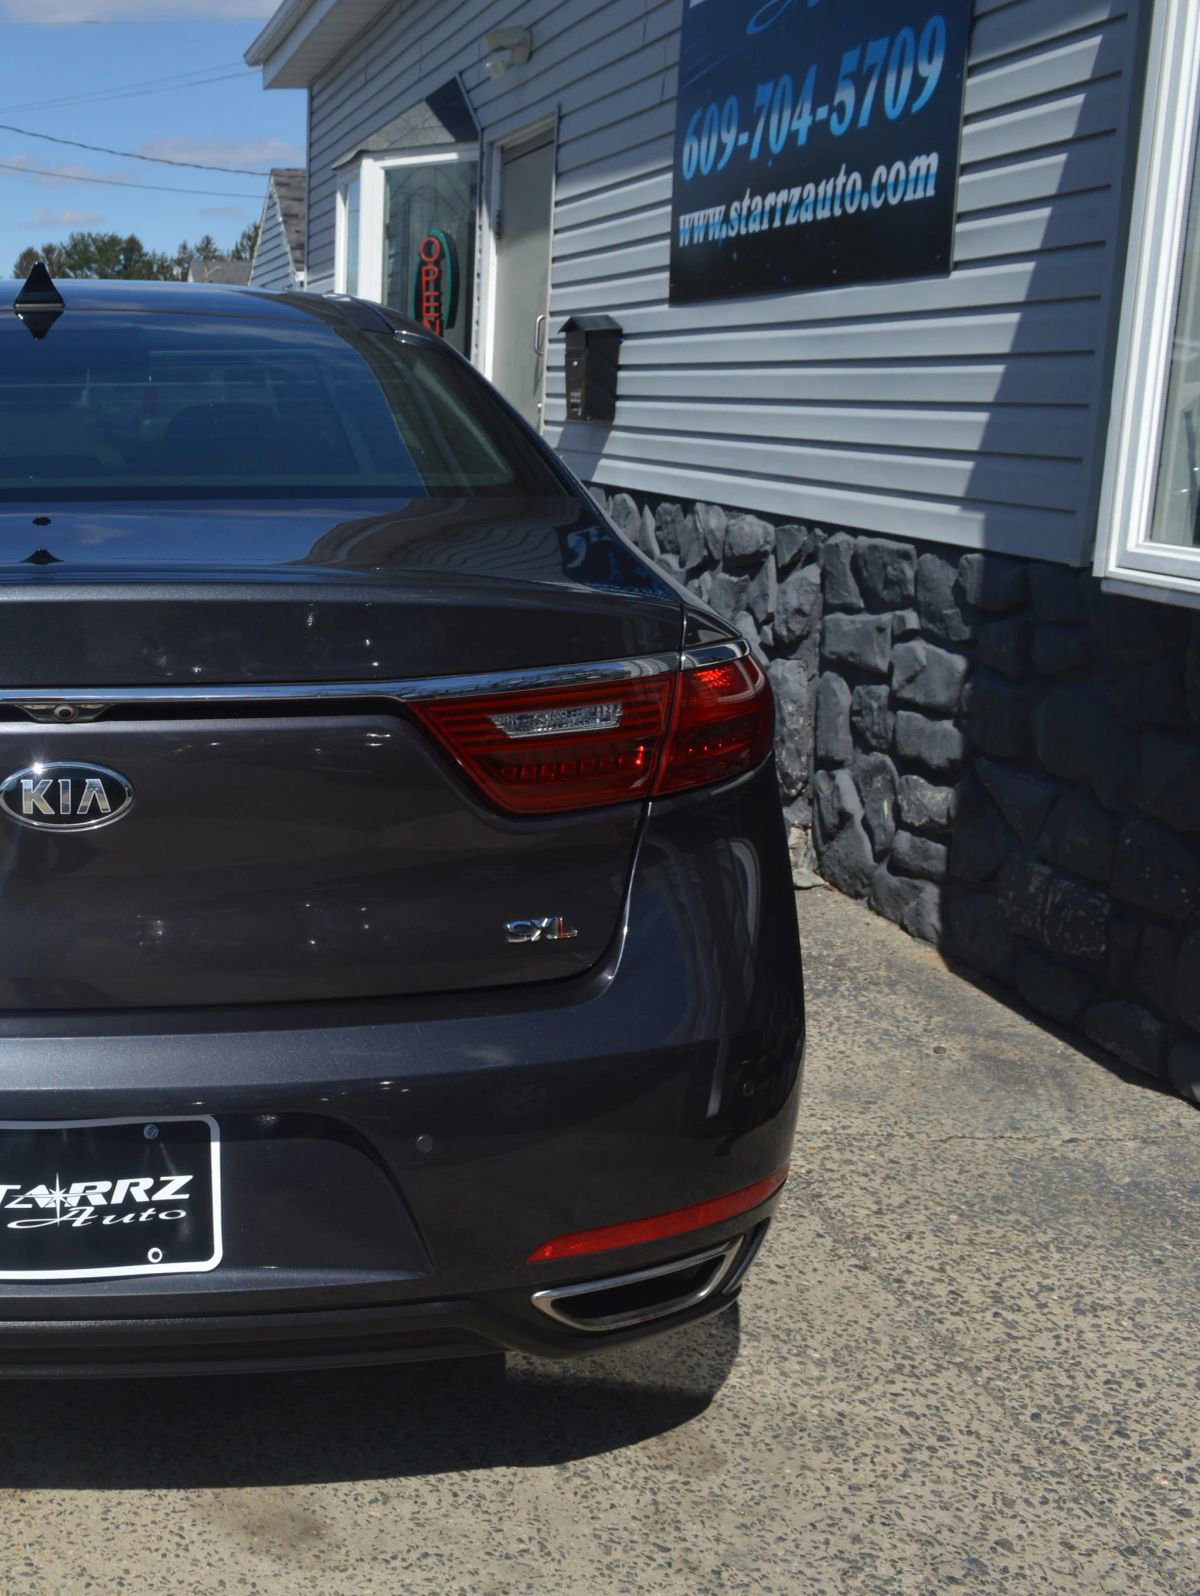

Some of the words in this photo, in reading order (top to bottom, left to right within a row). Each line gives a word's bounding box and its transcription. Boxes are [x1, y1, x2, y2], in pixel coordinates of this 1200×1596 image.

[682, 15, 947, 181] 609-704-5709
[678, 151, 939, 247] www.starrzauto.com
[20, 778, 112, 815] KIA
[6, 1206, 188, 1229] Auto
